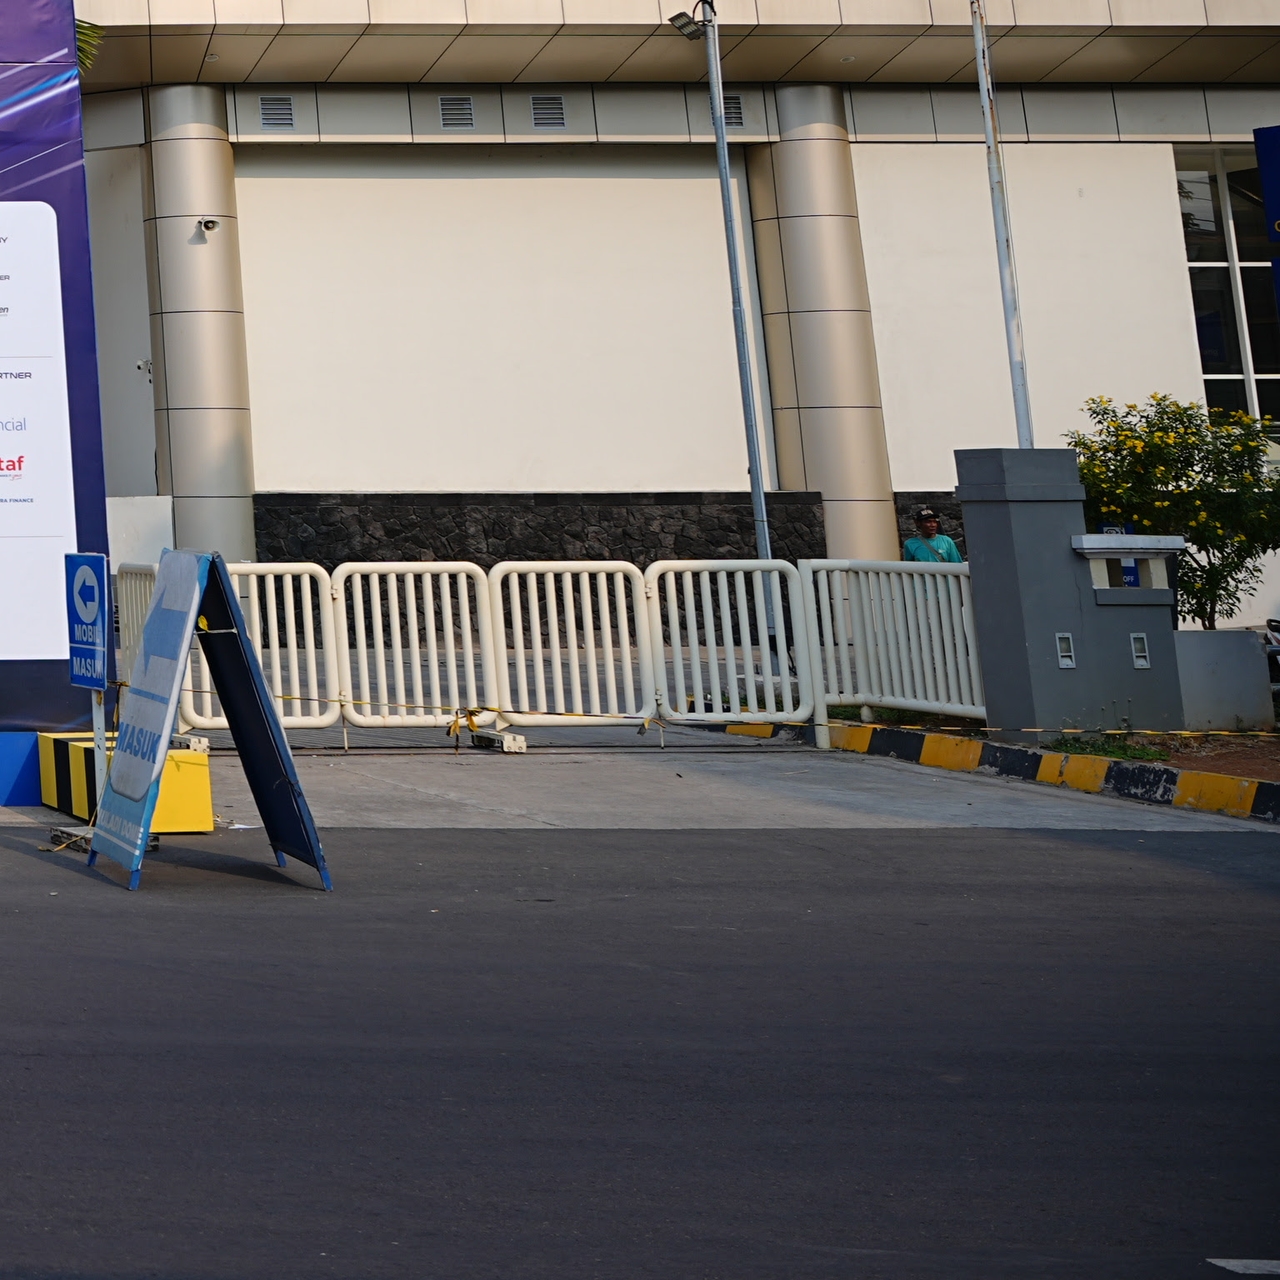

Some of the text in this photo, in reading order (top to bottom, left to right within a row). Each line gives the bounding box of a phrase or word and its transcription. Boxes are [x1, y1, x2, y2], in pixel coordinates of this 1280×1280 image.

[74, 624, 101, 643] MOBIL
[72, 658, 103, 680] MASUK
[116, 721, 161, 765] MASUK
